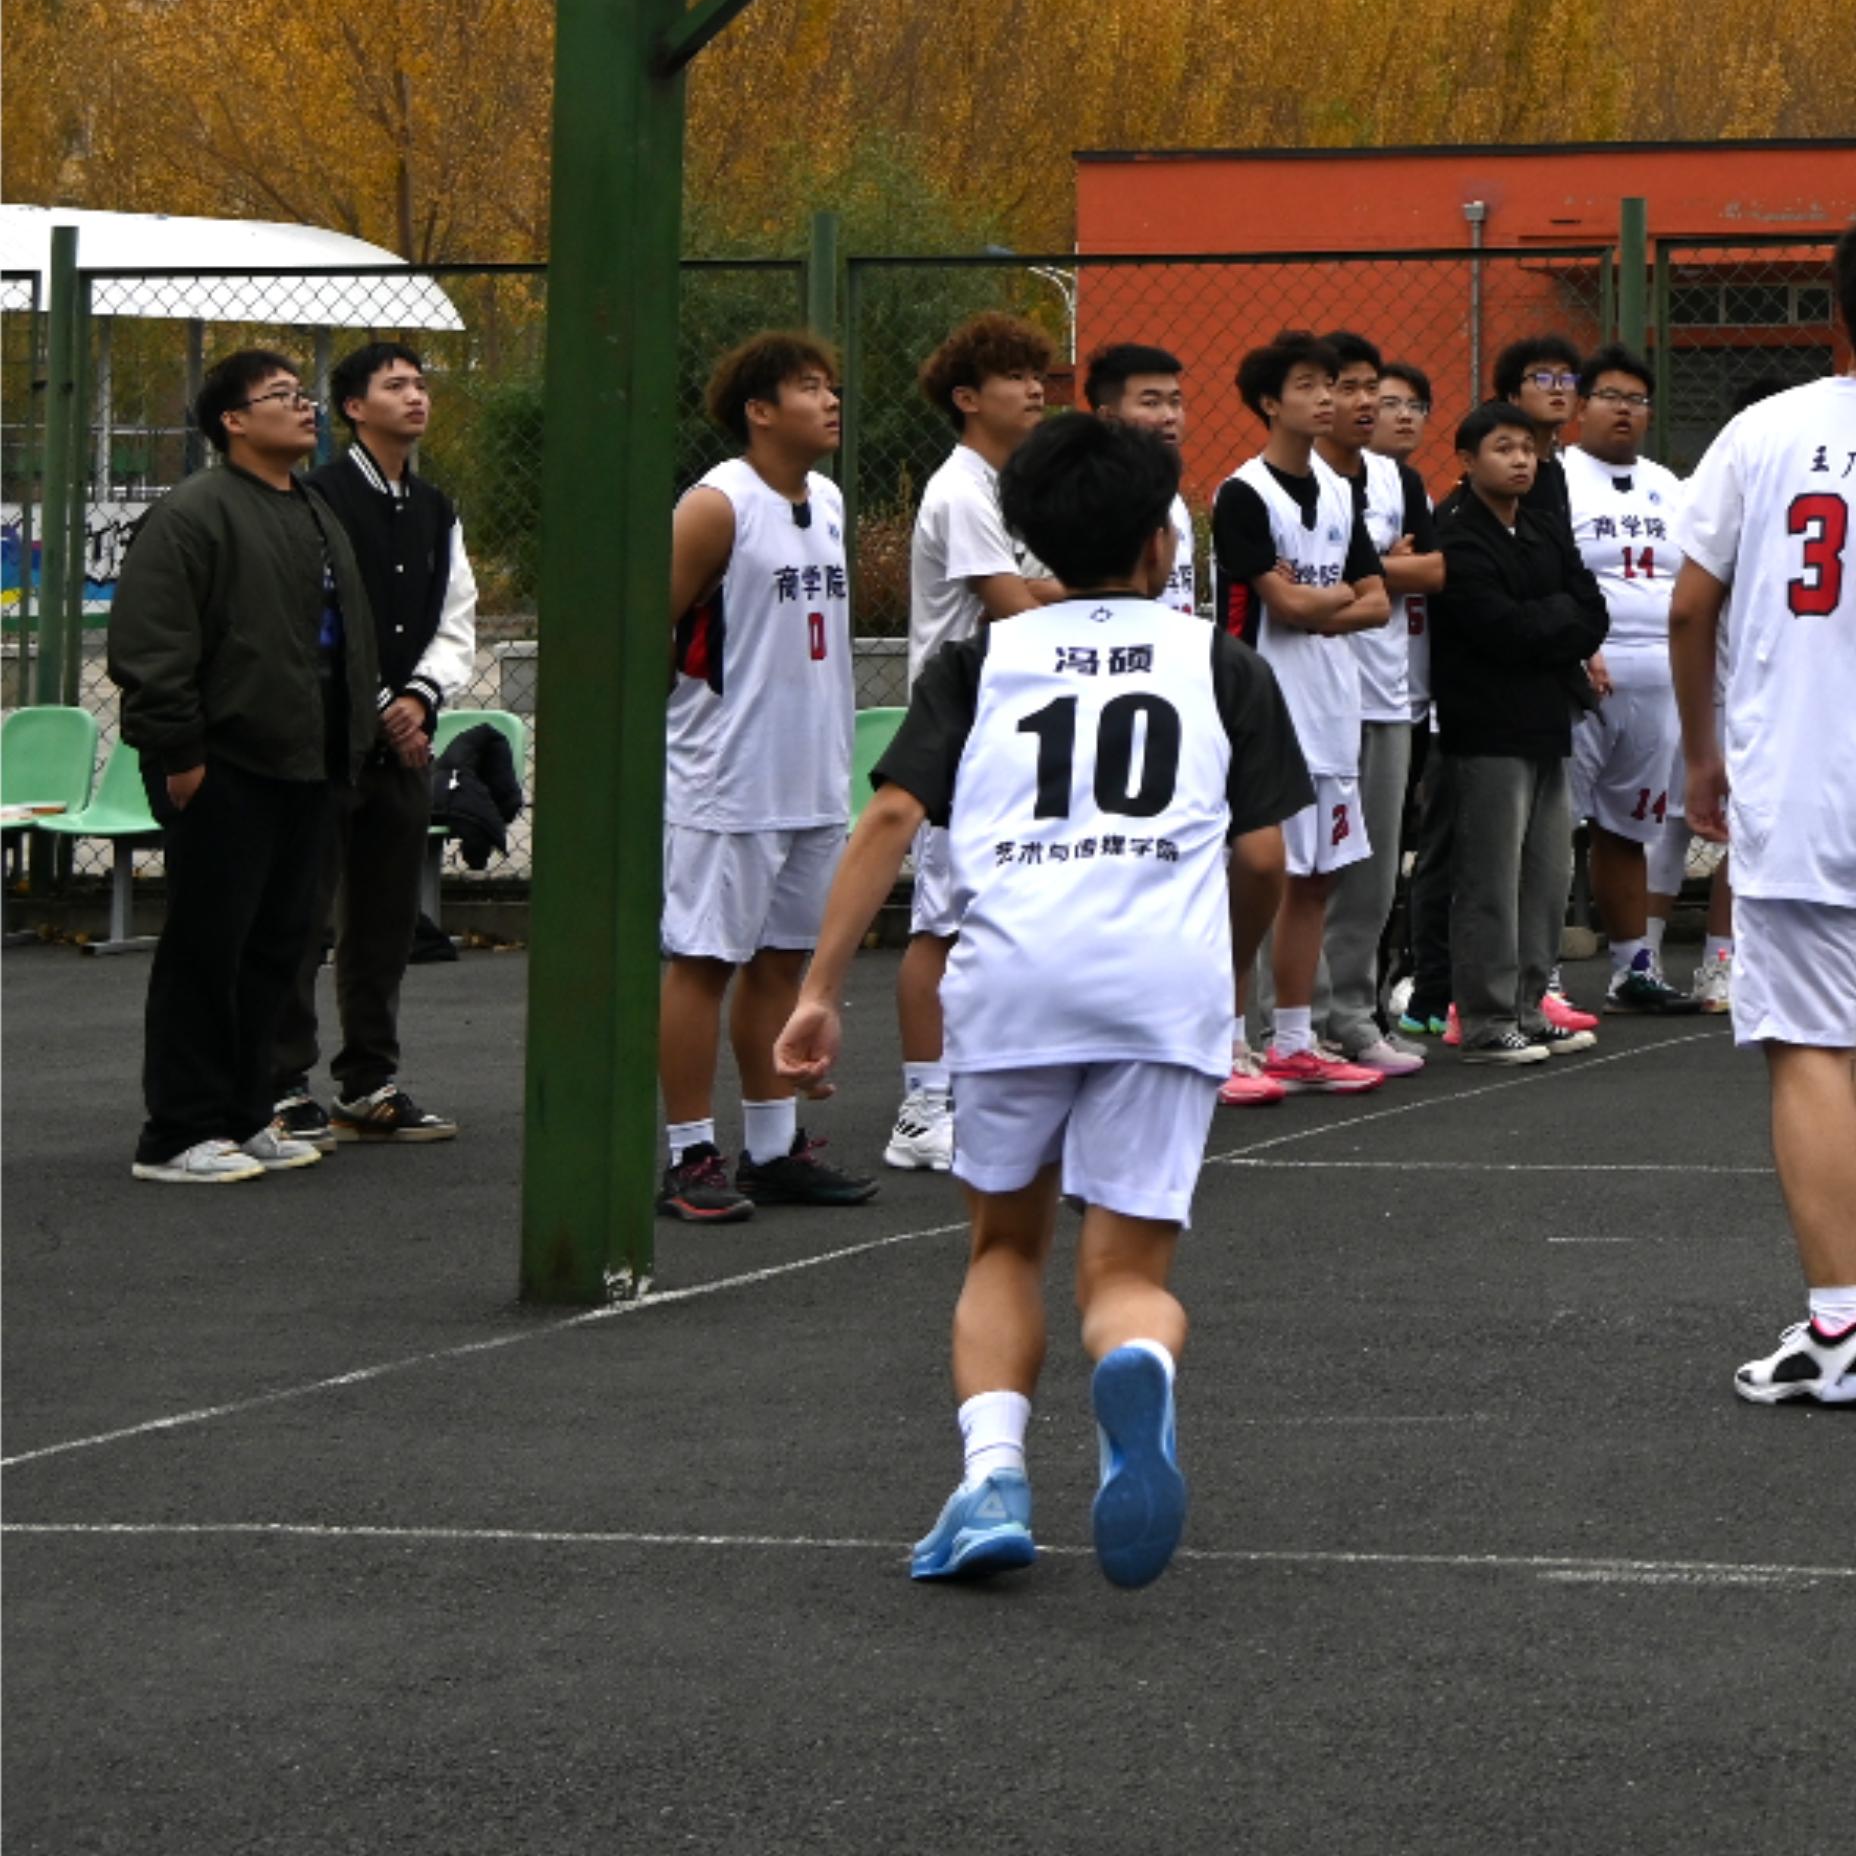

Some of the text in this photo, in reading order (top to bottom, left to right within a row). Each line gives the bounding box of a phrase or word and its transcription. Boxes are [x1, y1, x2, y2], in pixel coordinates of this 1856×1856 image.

[1590, 514, 1667, 541] 商学院
[1620, 545, 1655, 579] 14
[773, 564, 847, 603] 商学院
[808, 611, 827, 661] 0
[1054, 643, 1155, 675] 冯硕
[1016, 691, 1183, 821] 10
[1630, 788, 1667, 824] 14
